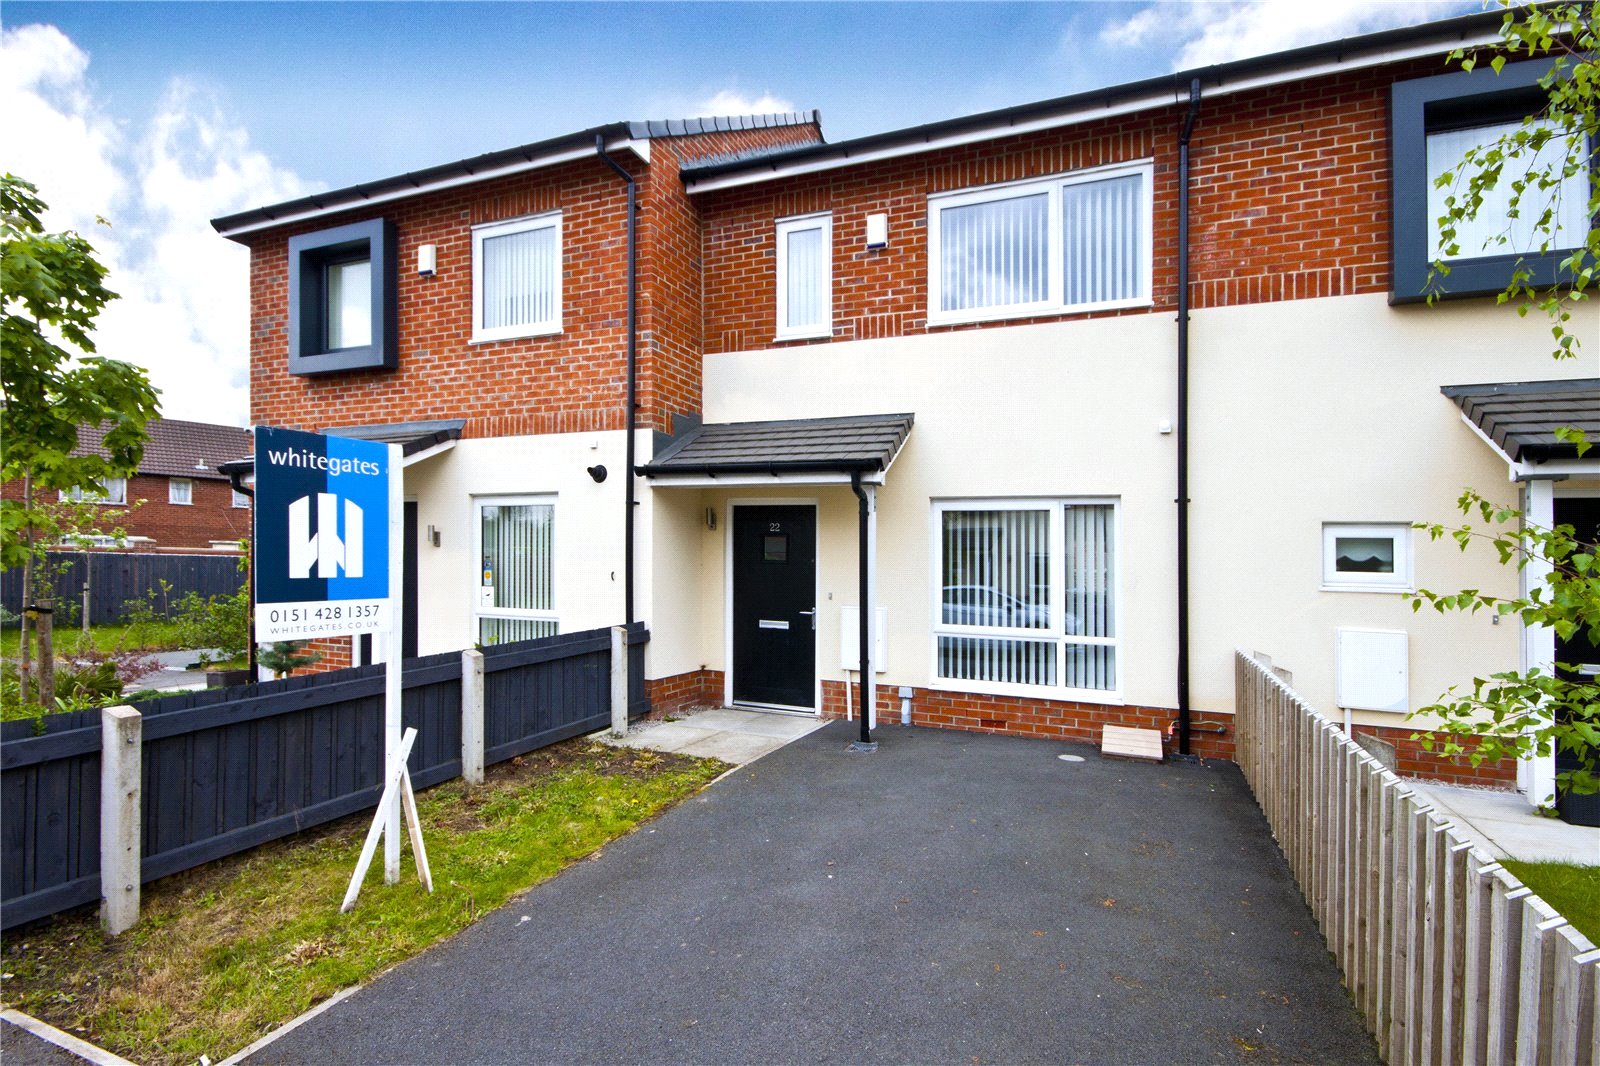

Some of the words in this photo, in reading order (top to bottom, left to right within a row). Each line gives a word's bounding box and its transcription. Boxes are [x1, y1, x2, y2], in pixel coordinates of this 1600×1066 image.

[268, 447, 380, 476] whitegates
[769, 522, 781, 532] 22
[270, 608, 307, 623] 0151
[315, 607, 342, 620] 428
[348, 605, 379, 618] 1357
[270, 621, 379, 634] WHITEGATES.CO.UK
